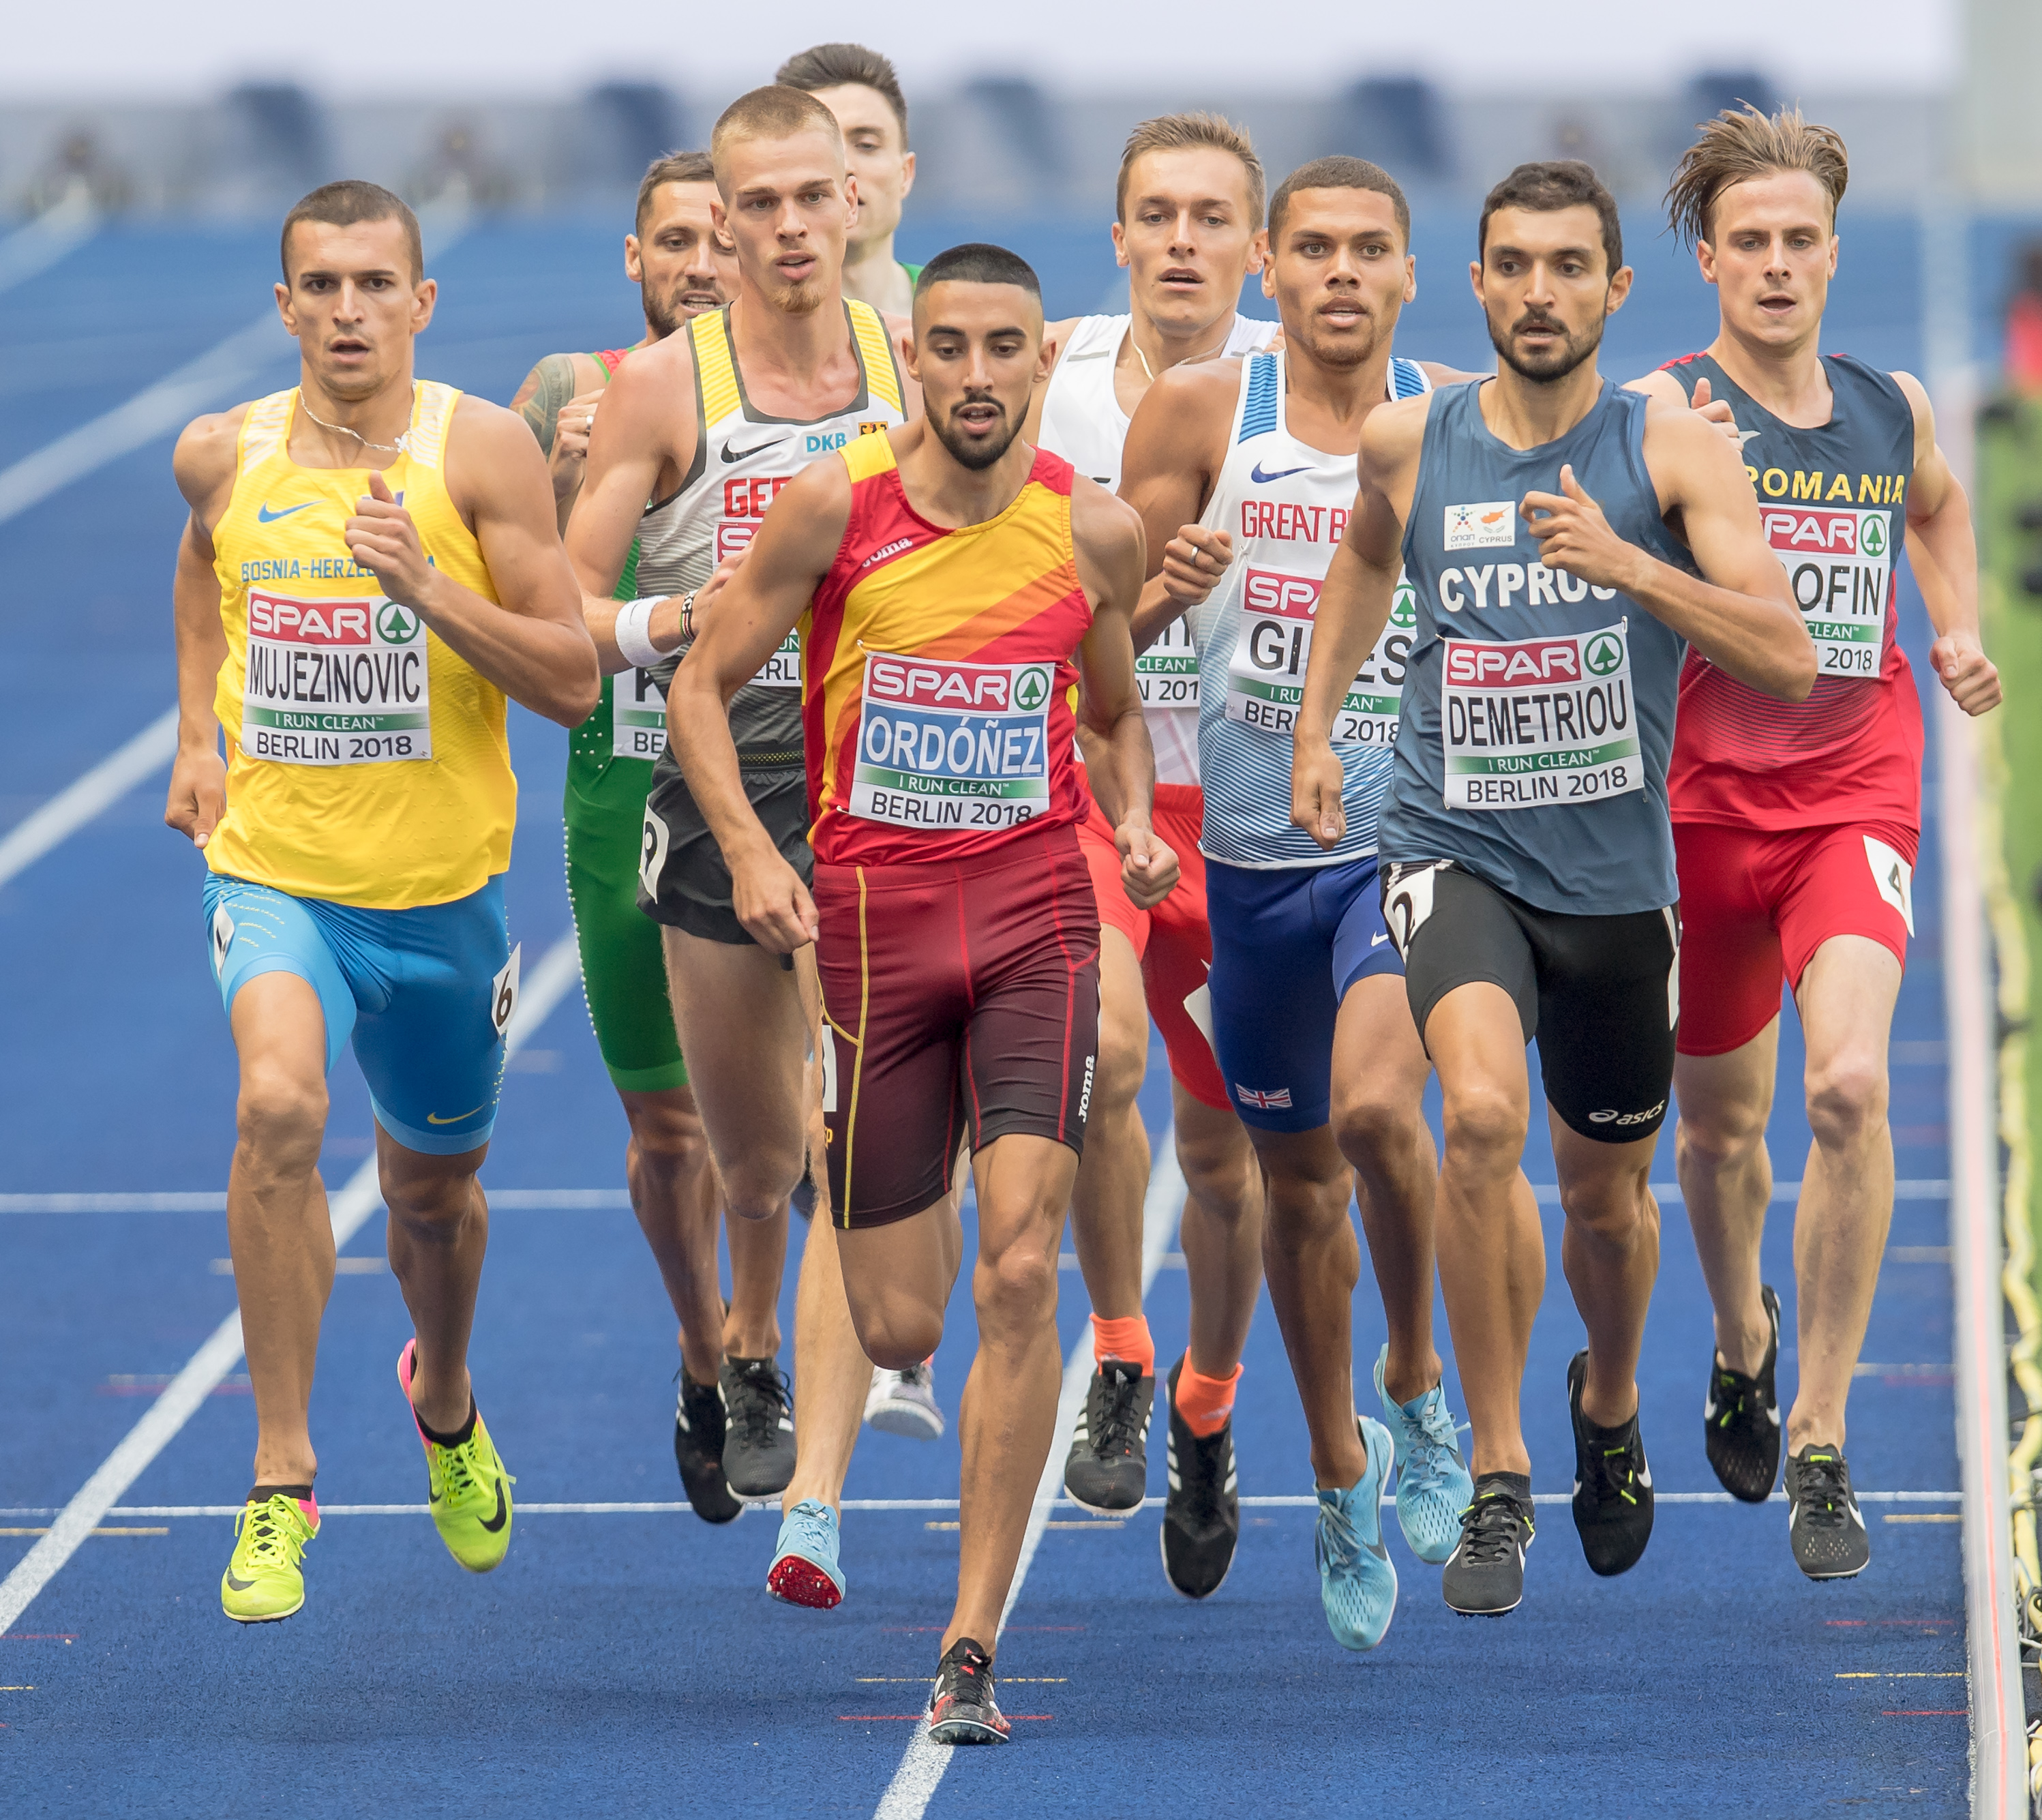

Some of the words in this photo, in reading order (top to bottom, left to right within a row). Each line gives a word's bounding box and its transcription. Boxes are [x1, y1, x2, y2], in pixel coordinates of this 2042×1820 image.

[806, 432, 847, 453] DKB
[1242, 501, 1327, 543] GREAT
[1478, 535, 1512, 543] CYPRUS
[1759, 513, 1855, 549] PAR
[1248, 576, 1320, 615] SP
[1781, 561, 1882, 616] OFIN
[251, 599, 367, 639] SPAR
[1250, 620, 1413, 685] GIS
[1450, 650, 1577, 681] SPAR
[1825, 646, 1872, 671] 2018
[250, 644, 420, 704] MUJEZINOVIC
[873, 663, 1007, 706] SPAR
[1158, 680, 1199, 701] 201
[1280, 688, 1302, 702] RU
[275, 713, 280, 726] I
[283, 714, 317, 729] RUN
[1342, 717, 1399, 743] 2018
[1448, 679, 1627, 747] DEMETRIOU
[257, 732, 340, 760] BERLIN
[349, 735, 412, 758] 2018
[866, 716, 1042, 775] ORDÓÑEZ
[1488, 759, 1493, 771] I
[1497, 756, 1533, 771] RUN
[899, 774, 904, 788] I
[908, 777, 944, 794] RUN
[1467, 775, 1559, 803] BERLIN
[1568, 765, 1627, 796] 2018
[871, 792, 963, 824] BERLIN
[972, 802, 1032, 825] 2018
[496, 968, 512, 1027] 6
[1079, 1055, 1095, 1123] Joma
[1616, 1099, 1665, 1125] asics
